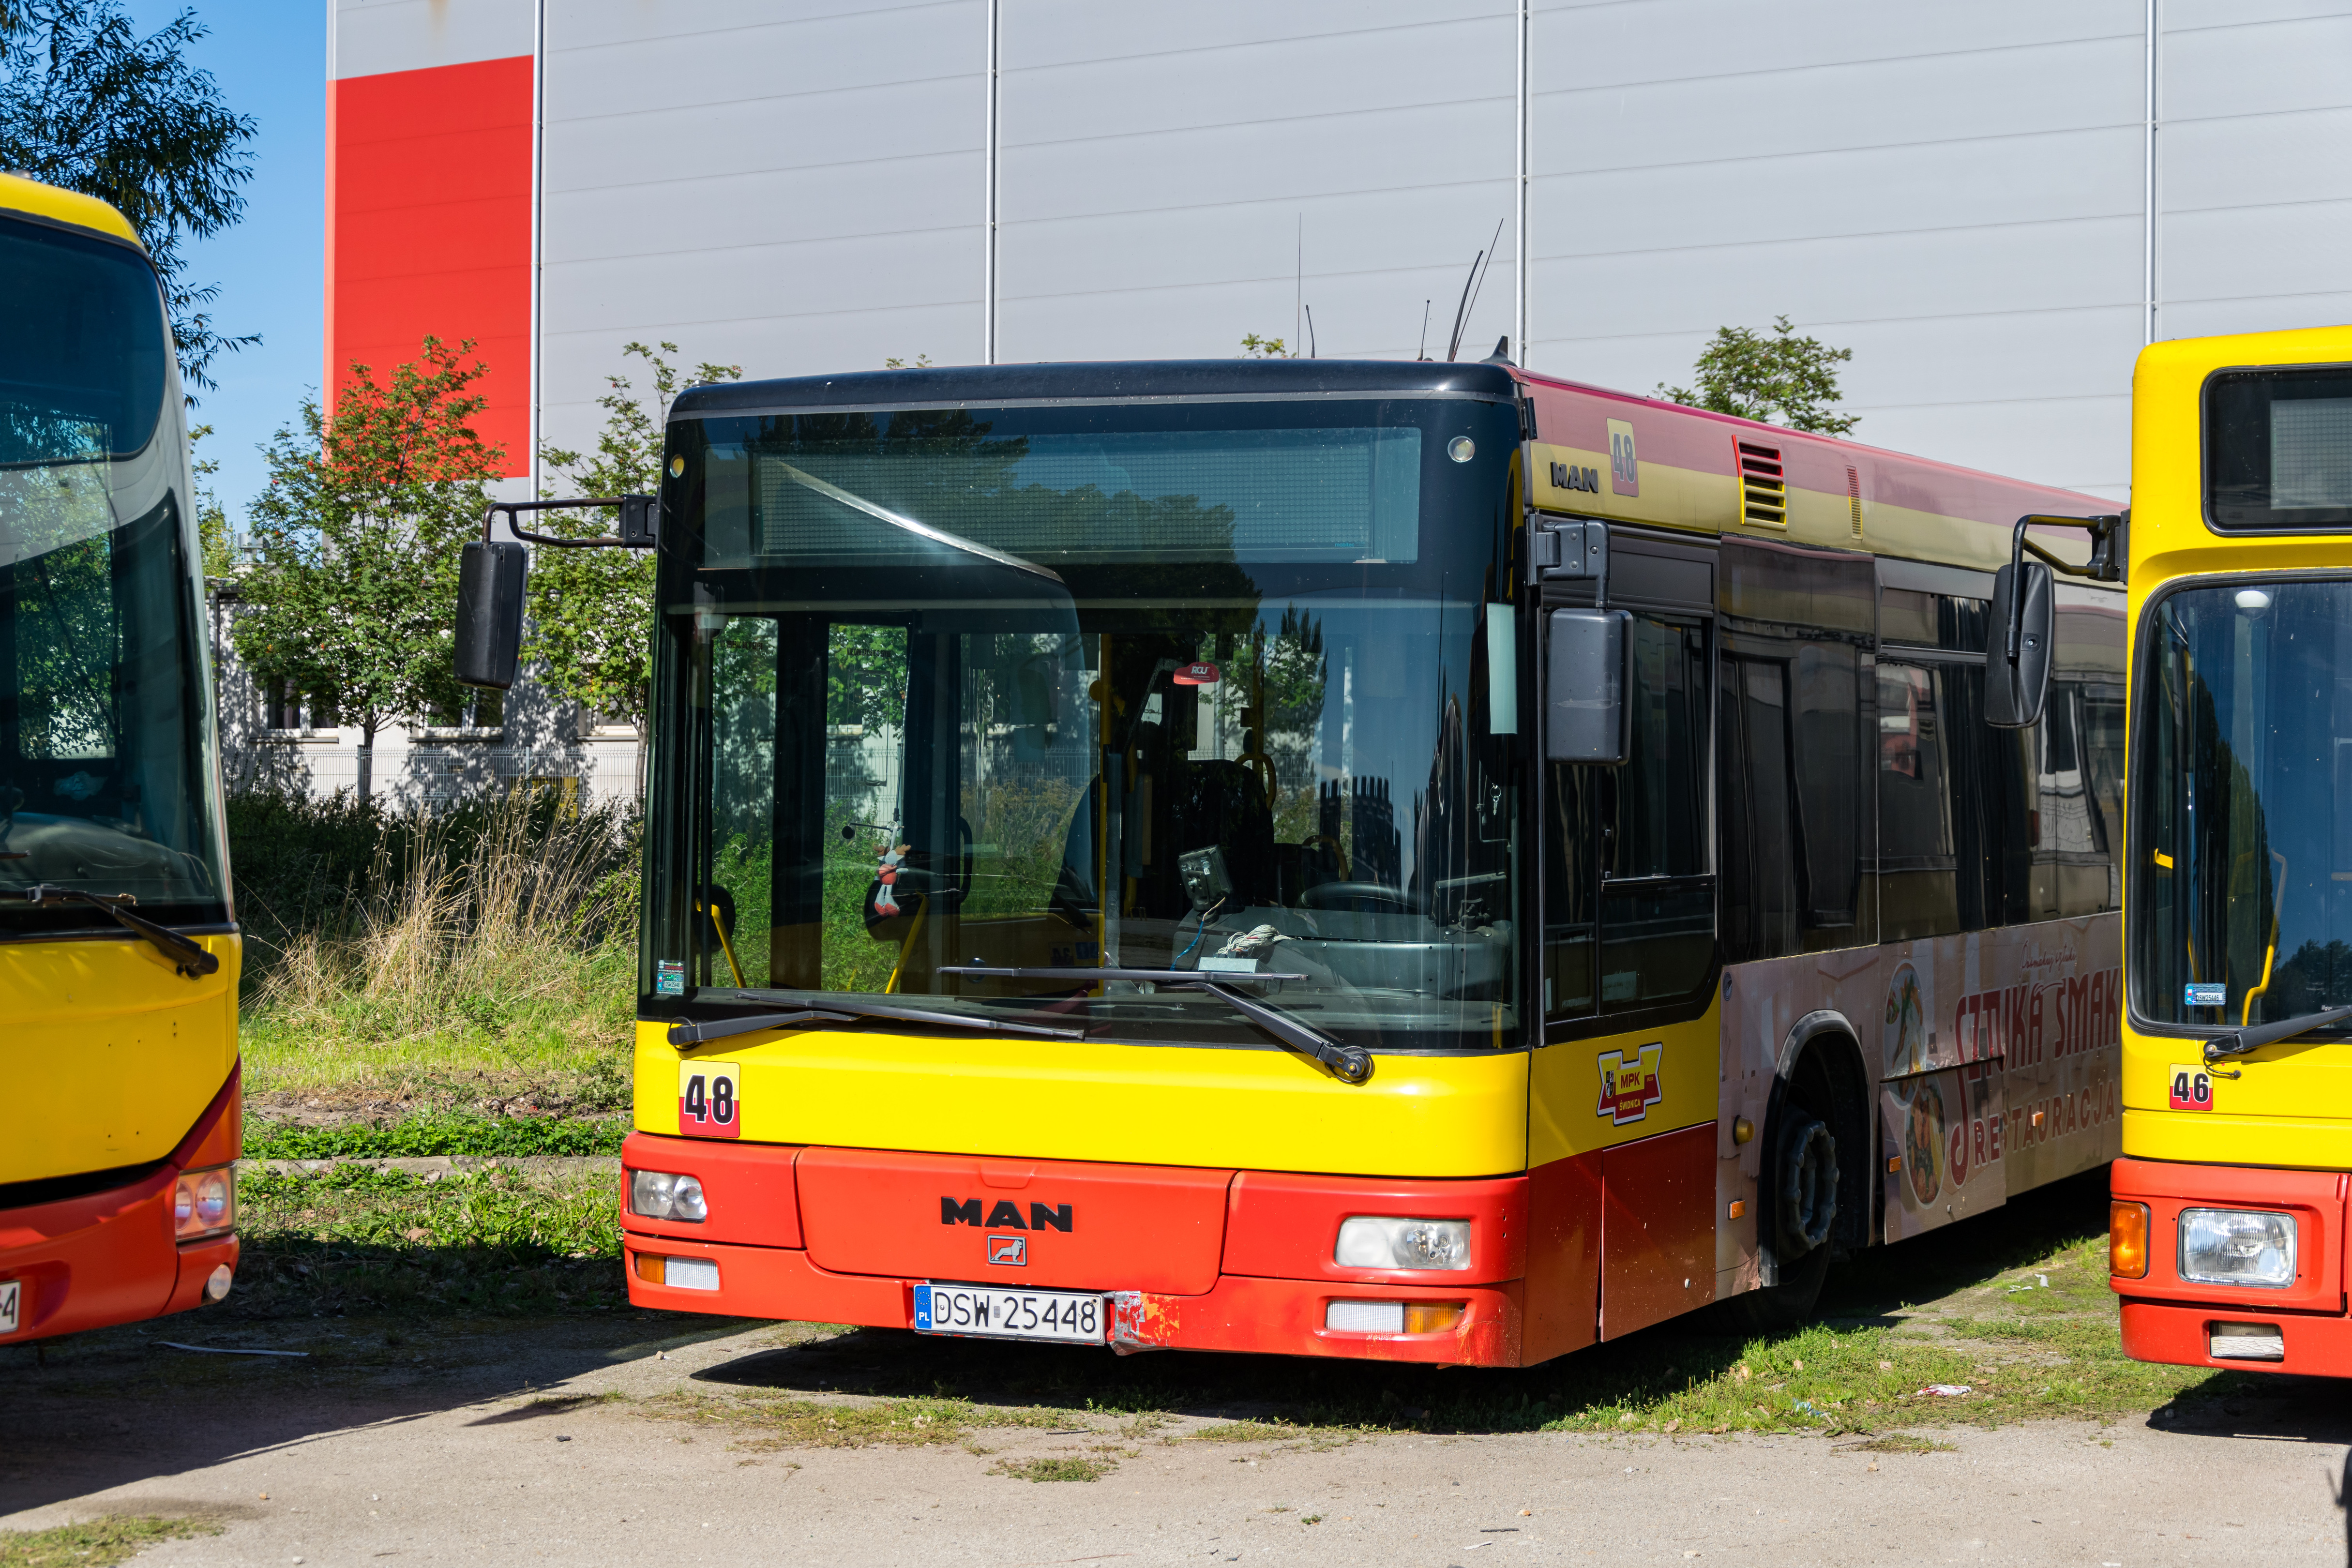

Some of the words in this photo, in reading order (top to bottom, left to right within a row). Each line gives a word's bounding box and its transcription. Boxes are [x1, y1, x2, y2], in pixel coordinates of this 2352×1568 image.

[1613, 432, 1635, 483] 48
[1550, 462, 1598, 493] MAN
[2055, 967, 2123, 1058] SMAK
[684, 1074, 734, 1125] 48
[1620, 1071, 1640, 1089] MPK
[2172, 1071, 2209, 1103] 46
[1619, 1099, 1641, 1111] ŚWIDNICA
[1974, 1080, 2115, 1168] RESTAURACJA
[941, 1196, 1073, 1233] MAN
[919, 1312, 930, 1321] PL
[935, 1292, 990, 1327] DSW
[1003, 1296, 1096, 1334] 25448
